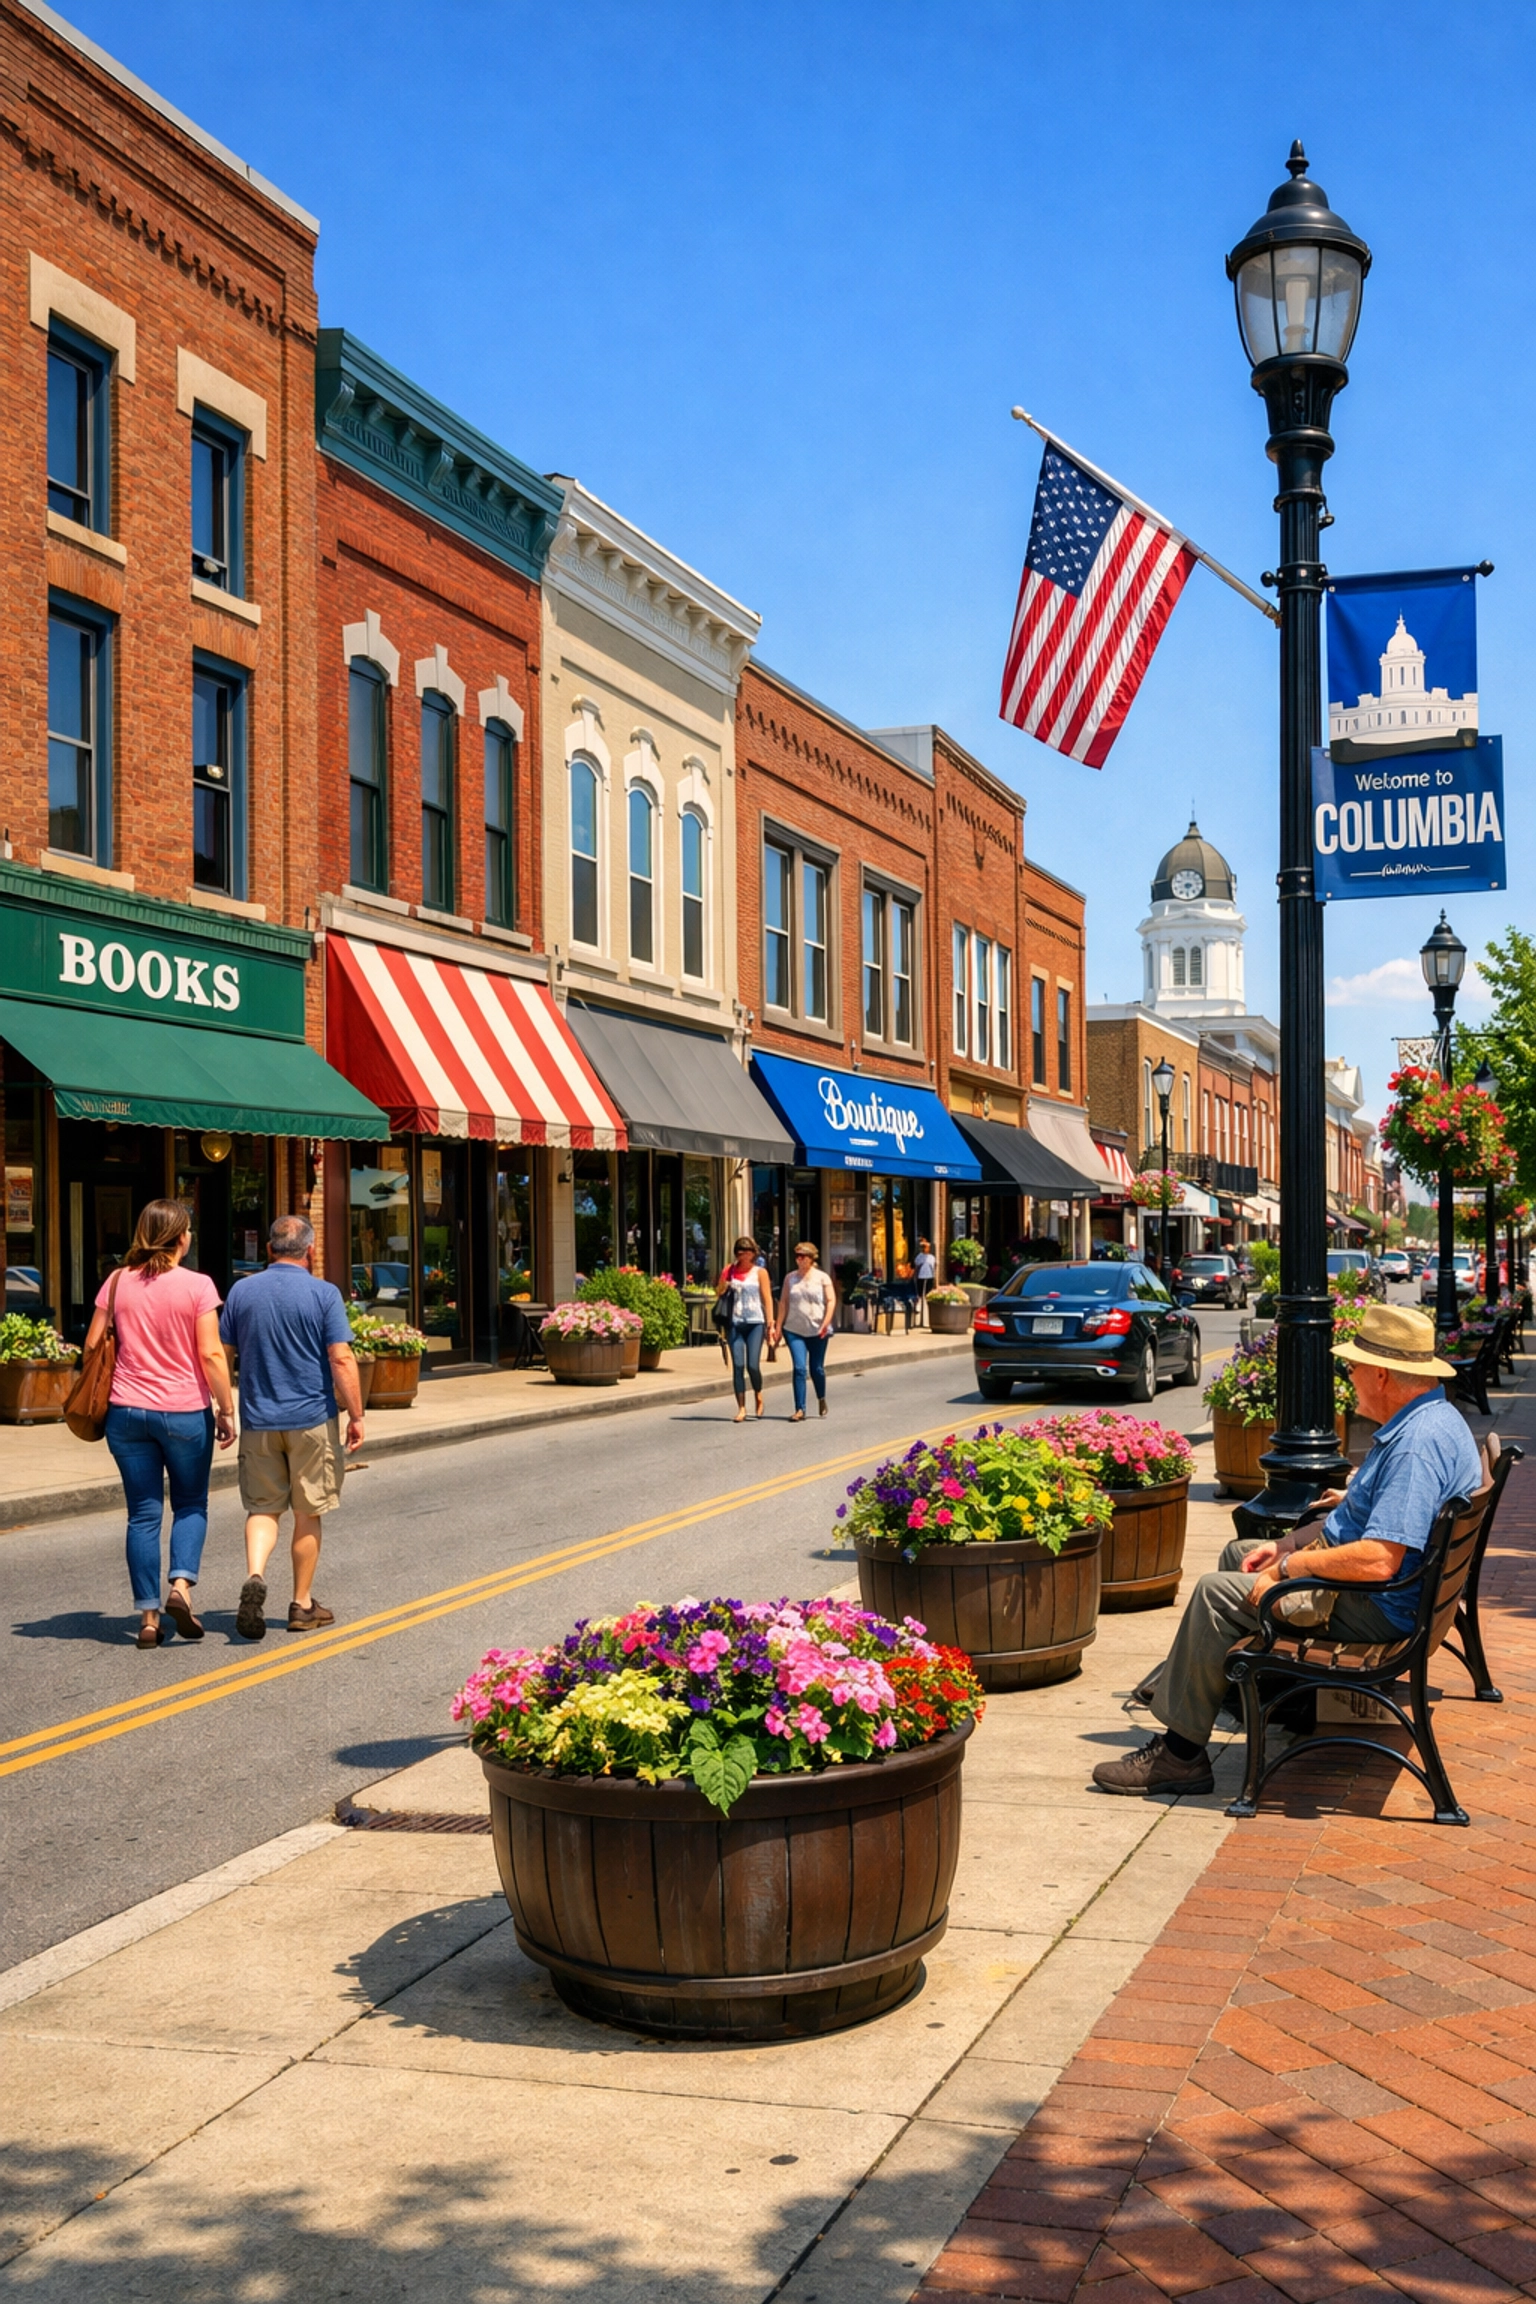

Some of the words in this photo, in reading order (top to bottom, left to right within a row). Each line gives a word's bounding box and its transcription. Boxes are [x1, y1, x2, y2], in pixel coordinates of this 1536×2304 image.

[1354, 772, 1431, 792] Welcome
[1435, 769, 1454, 786] to
[1315, 791, 1503, 855] COLUMBIA
[59, 932, 241, 1012] BOOKS
[818, 1076, 924, 1155] Boutique
